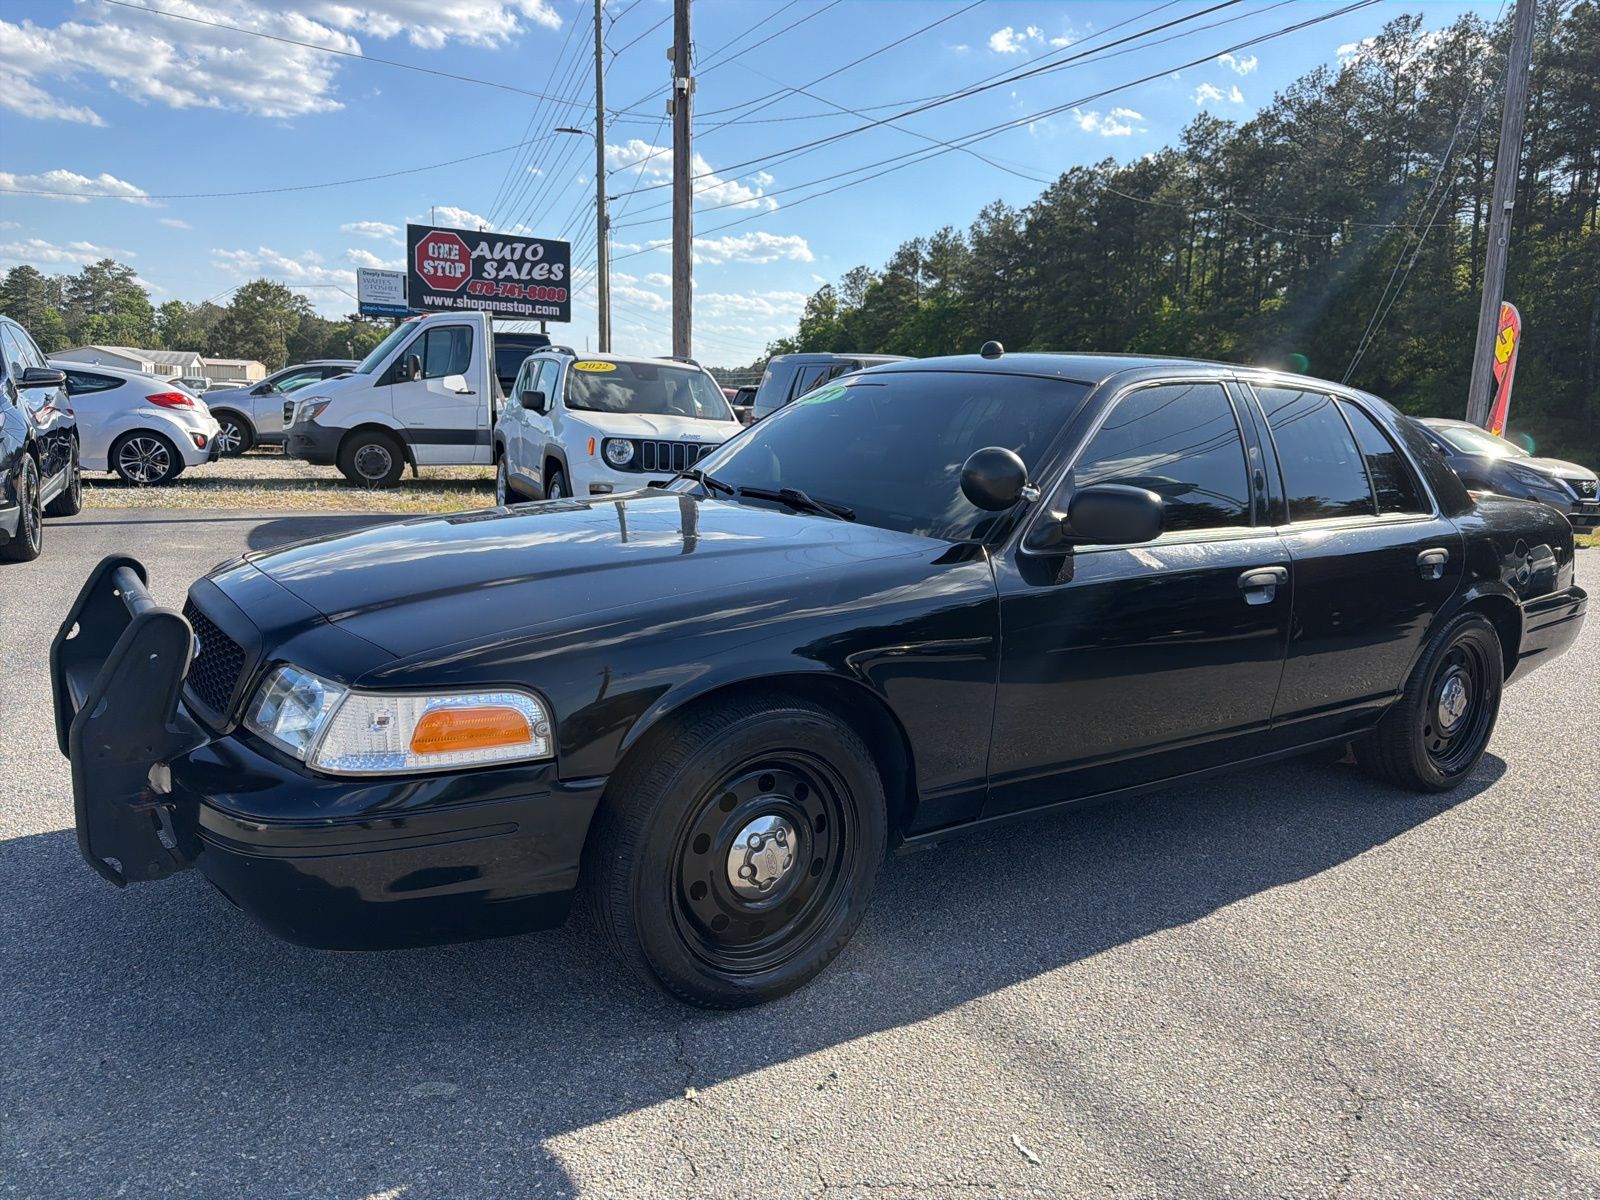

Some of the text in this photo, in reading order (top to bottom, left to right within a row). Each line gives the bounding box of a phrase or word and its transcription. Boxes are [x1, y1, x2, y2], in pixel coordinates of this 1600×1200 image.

[428, 242, 460, 260] ONE
[470, 241, 544, 261] AUTO
[423, 260, 466, 278] STOP
[481, 261, 565, 281] SALES
[423, 295, 560, 316] www.shoponestop.com
[581, 362, 609, 370] 2022
